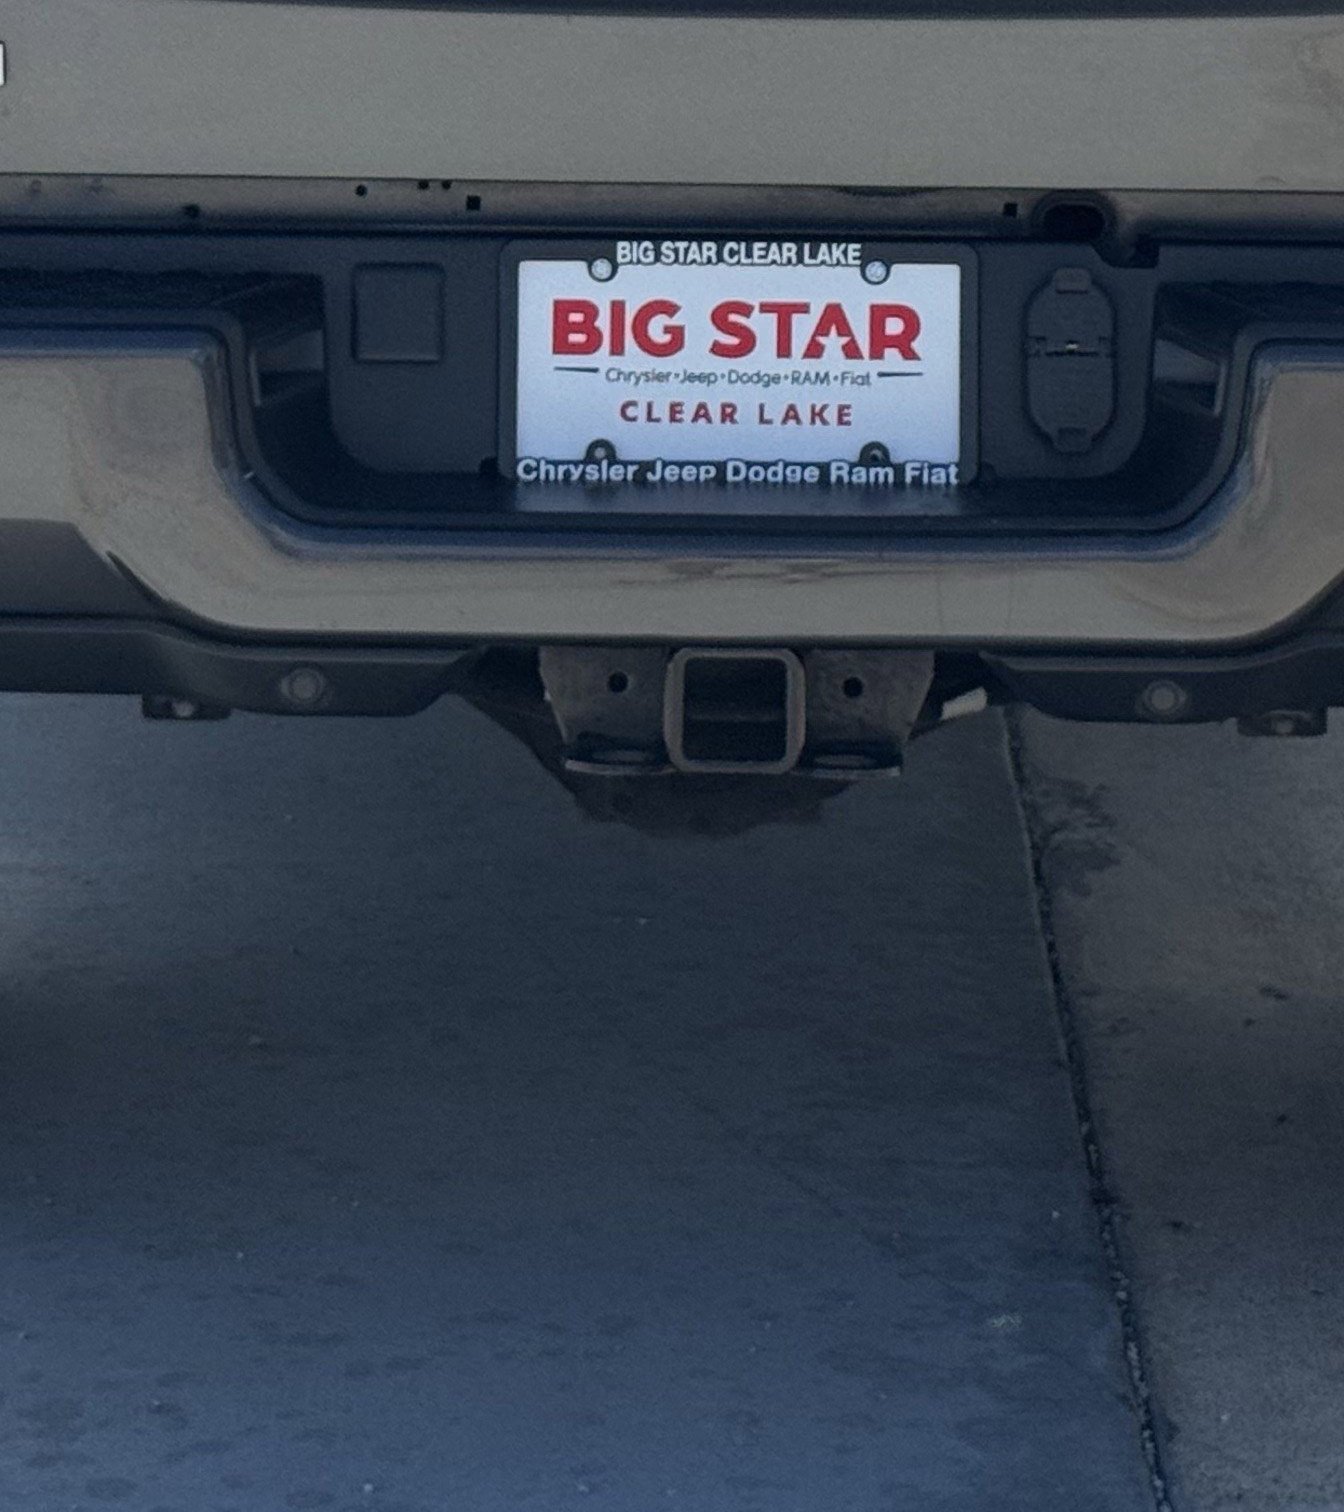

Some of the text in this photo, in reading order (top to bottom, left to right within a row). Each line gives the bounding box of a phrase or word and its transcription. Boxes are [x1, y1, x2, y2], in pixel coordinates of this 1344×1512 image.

[616, 241, 862, 266] BIG STAR CLEAR LAKE
[552, 299, 921, 361] BIG STAR
[619, 400, 853, 426] CLEAR LAKE
[516, 458, 959, 485] Chrysler Jeep Dodge Ram Fiat
